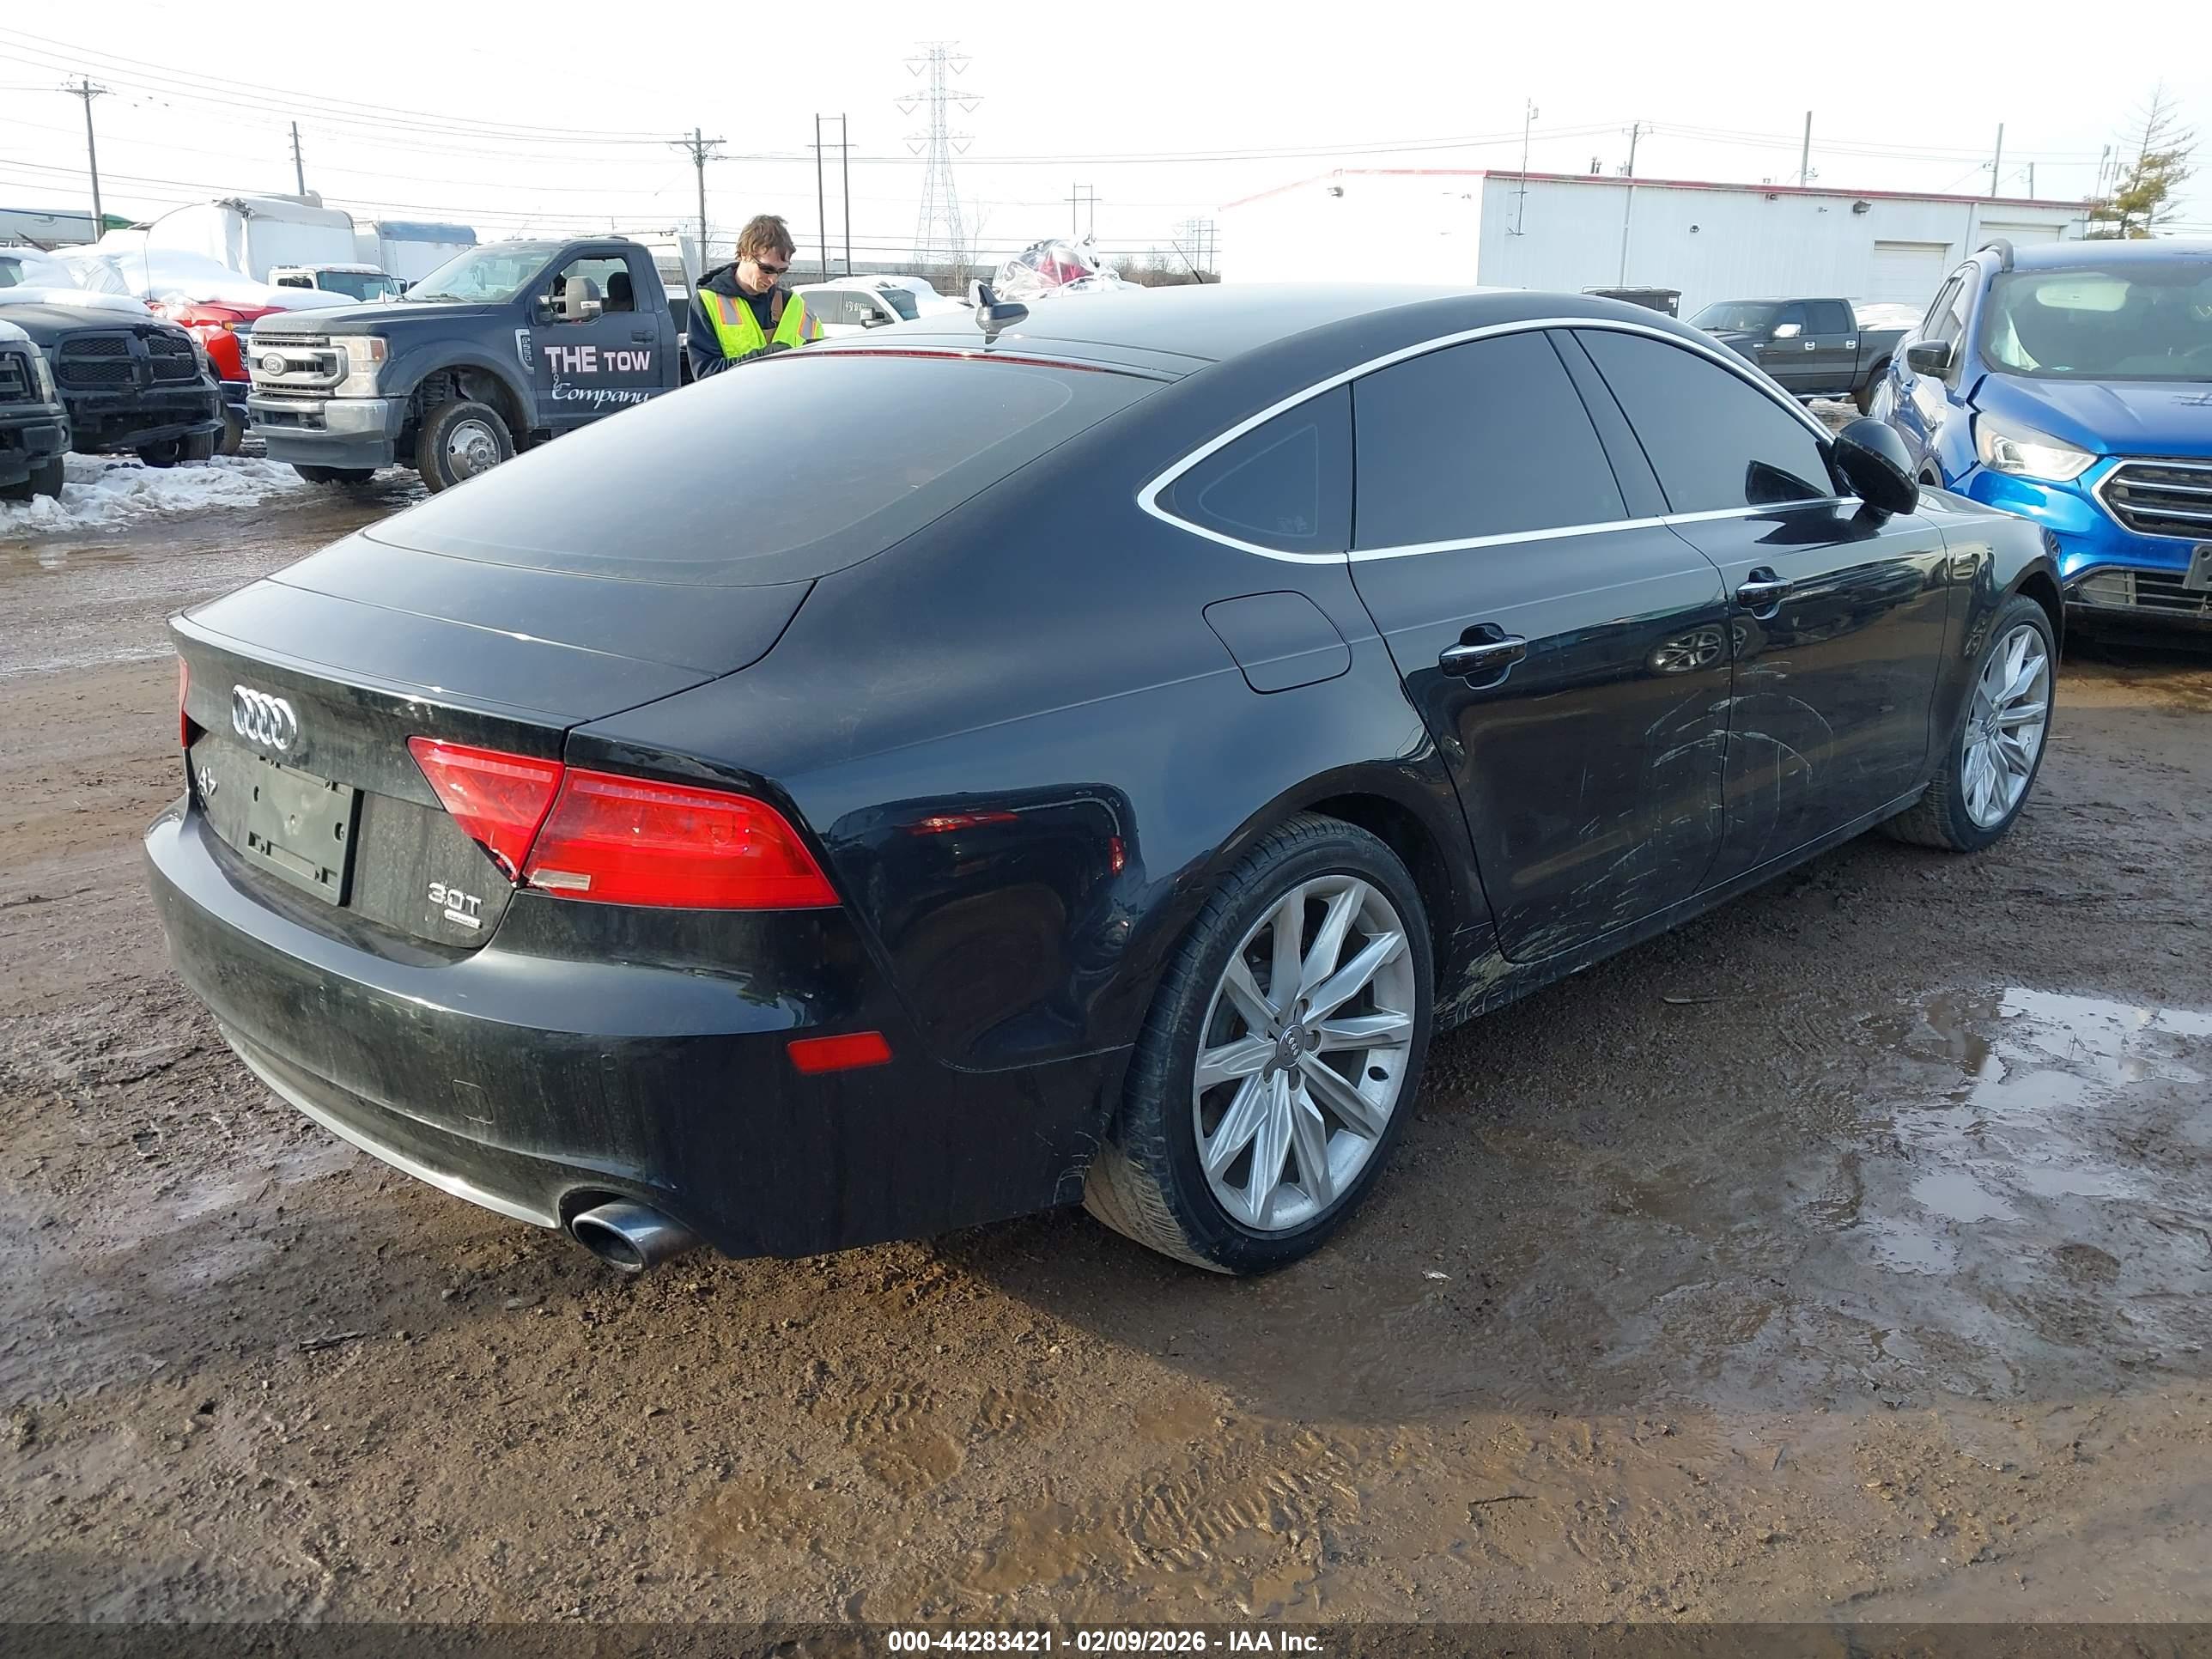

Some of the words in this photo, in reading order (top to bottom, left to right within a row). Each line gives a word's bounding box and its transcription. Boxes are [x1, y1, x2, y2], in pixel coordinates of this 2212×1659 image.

[544, 345, 598, 373] THE
[603, 350, 651, 372] TOW
[551, 383, 649, 410] Company
